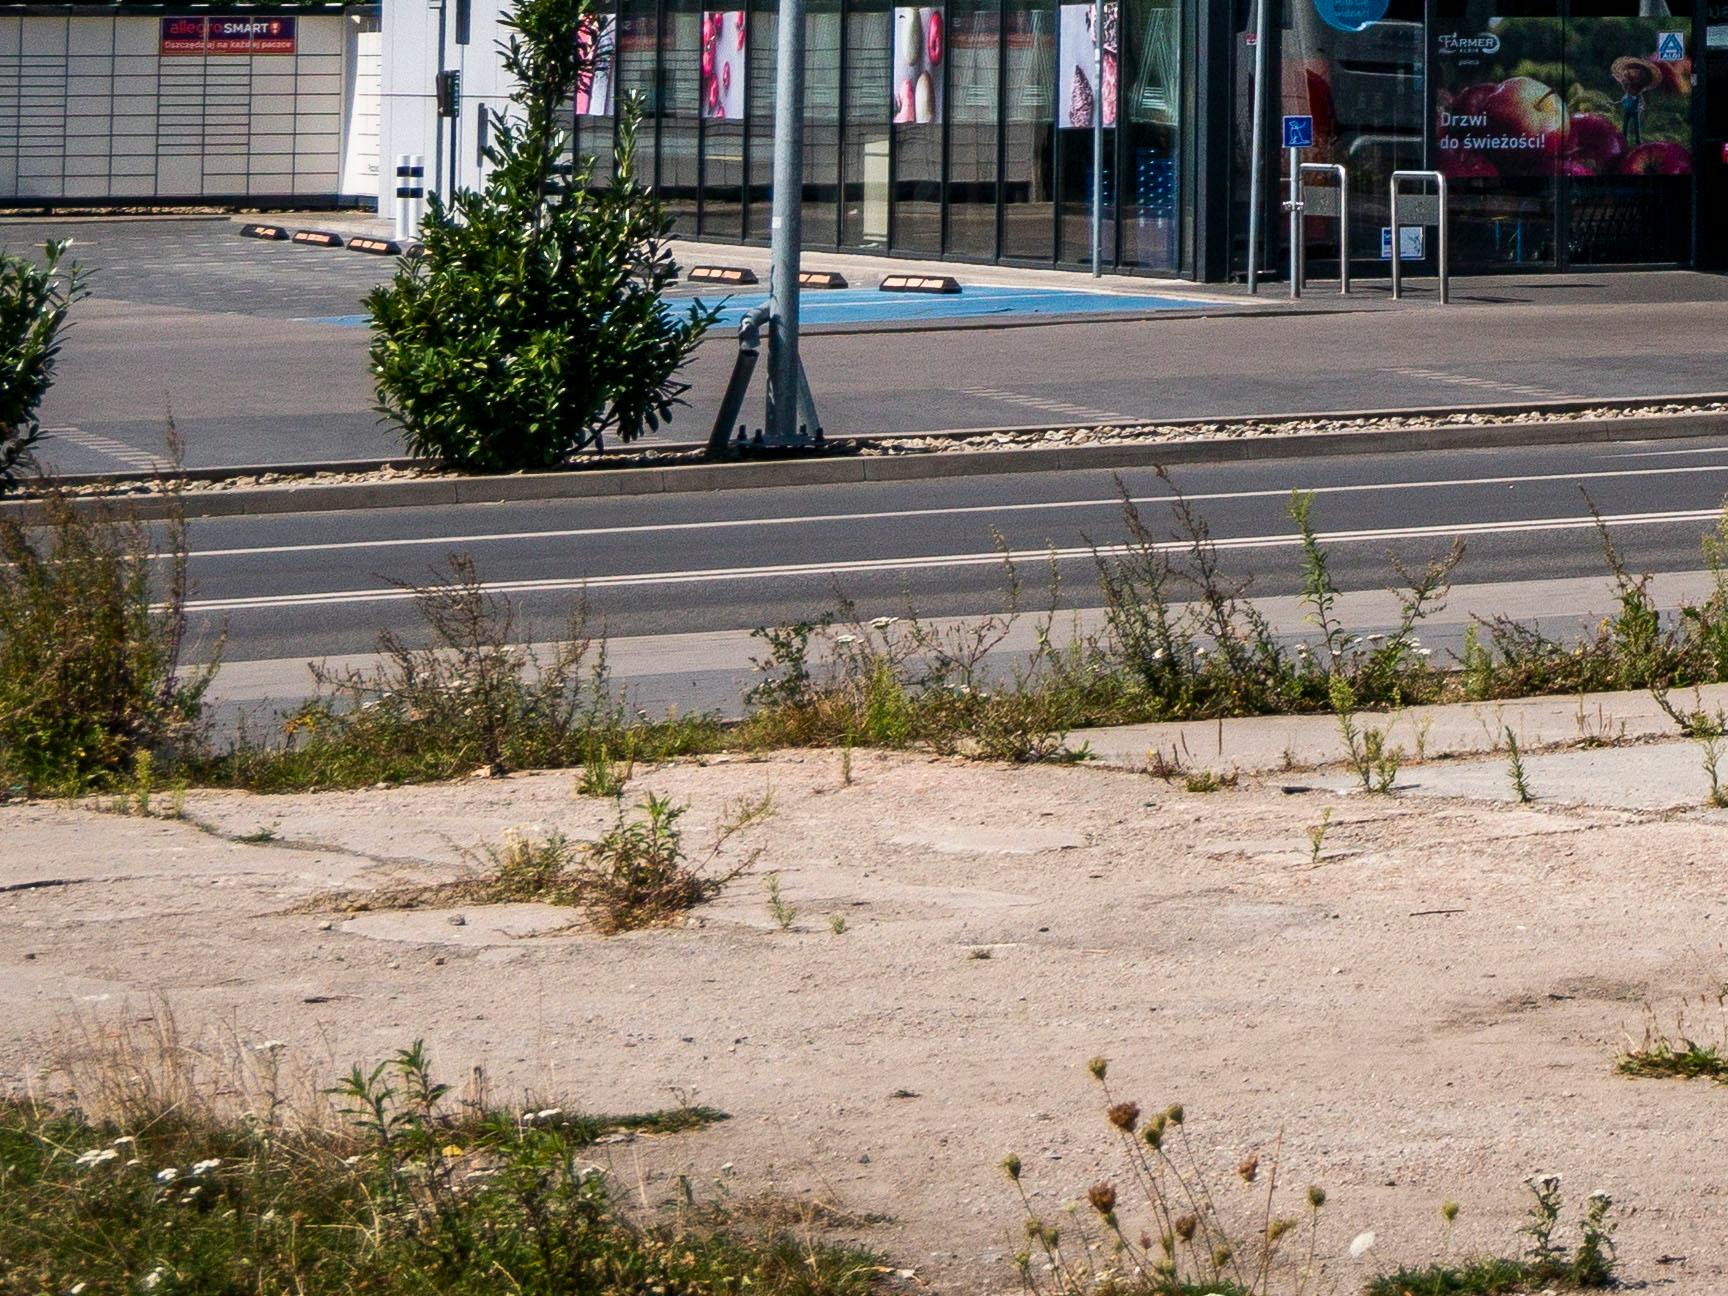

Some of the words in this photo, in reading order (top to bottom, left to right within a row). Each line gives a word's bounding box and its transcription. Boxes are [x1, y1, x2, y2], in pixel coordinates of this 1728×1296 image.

[170, 20, 220, 36] allegro
[1439, 33, 1495, 48] FARMER
[1440, 111, 1487, 126] Drzwi
[1440, 134, 1459, 149] do
[1463, 132, 1546, 149] świeżości!
